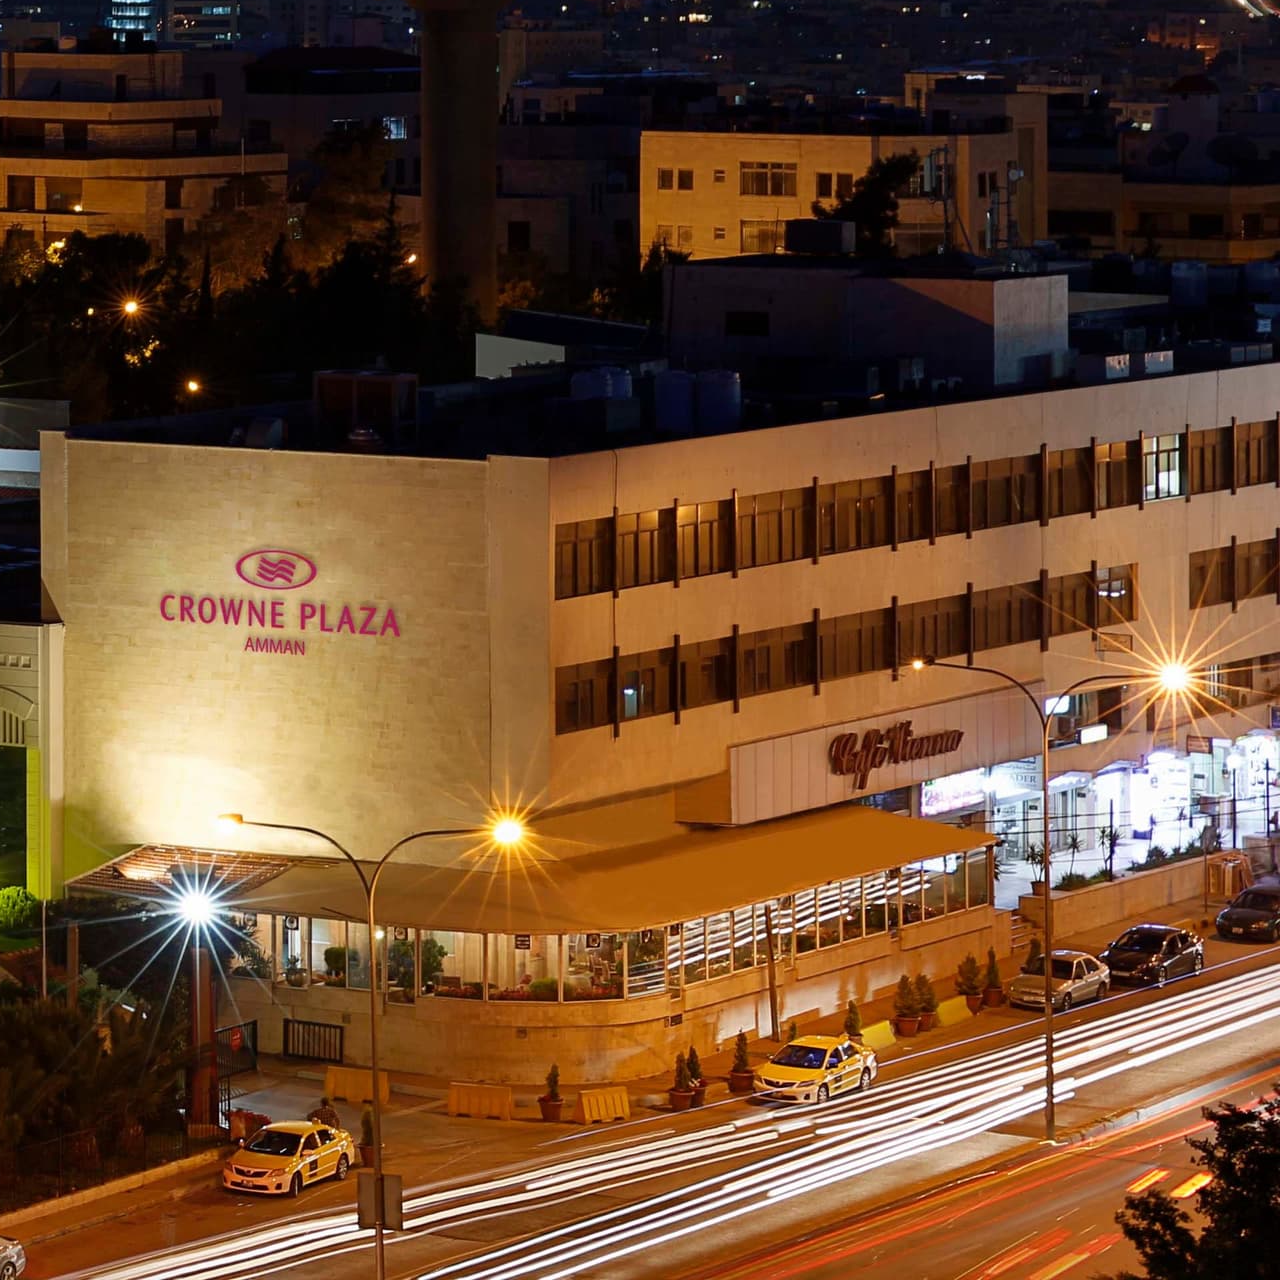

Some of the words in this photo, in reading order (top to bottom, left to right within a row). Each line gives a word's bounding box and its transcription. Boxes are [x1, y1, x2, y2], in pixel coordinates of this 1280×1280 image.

[159, 594, 285, 629] CROWNE
[299, 603, 401, 638] PLAZA
[244, 637, 306, 656] AMMAN
[886, 720, 965, 764] Vienna
